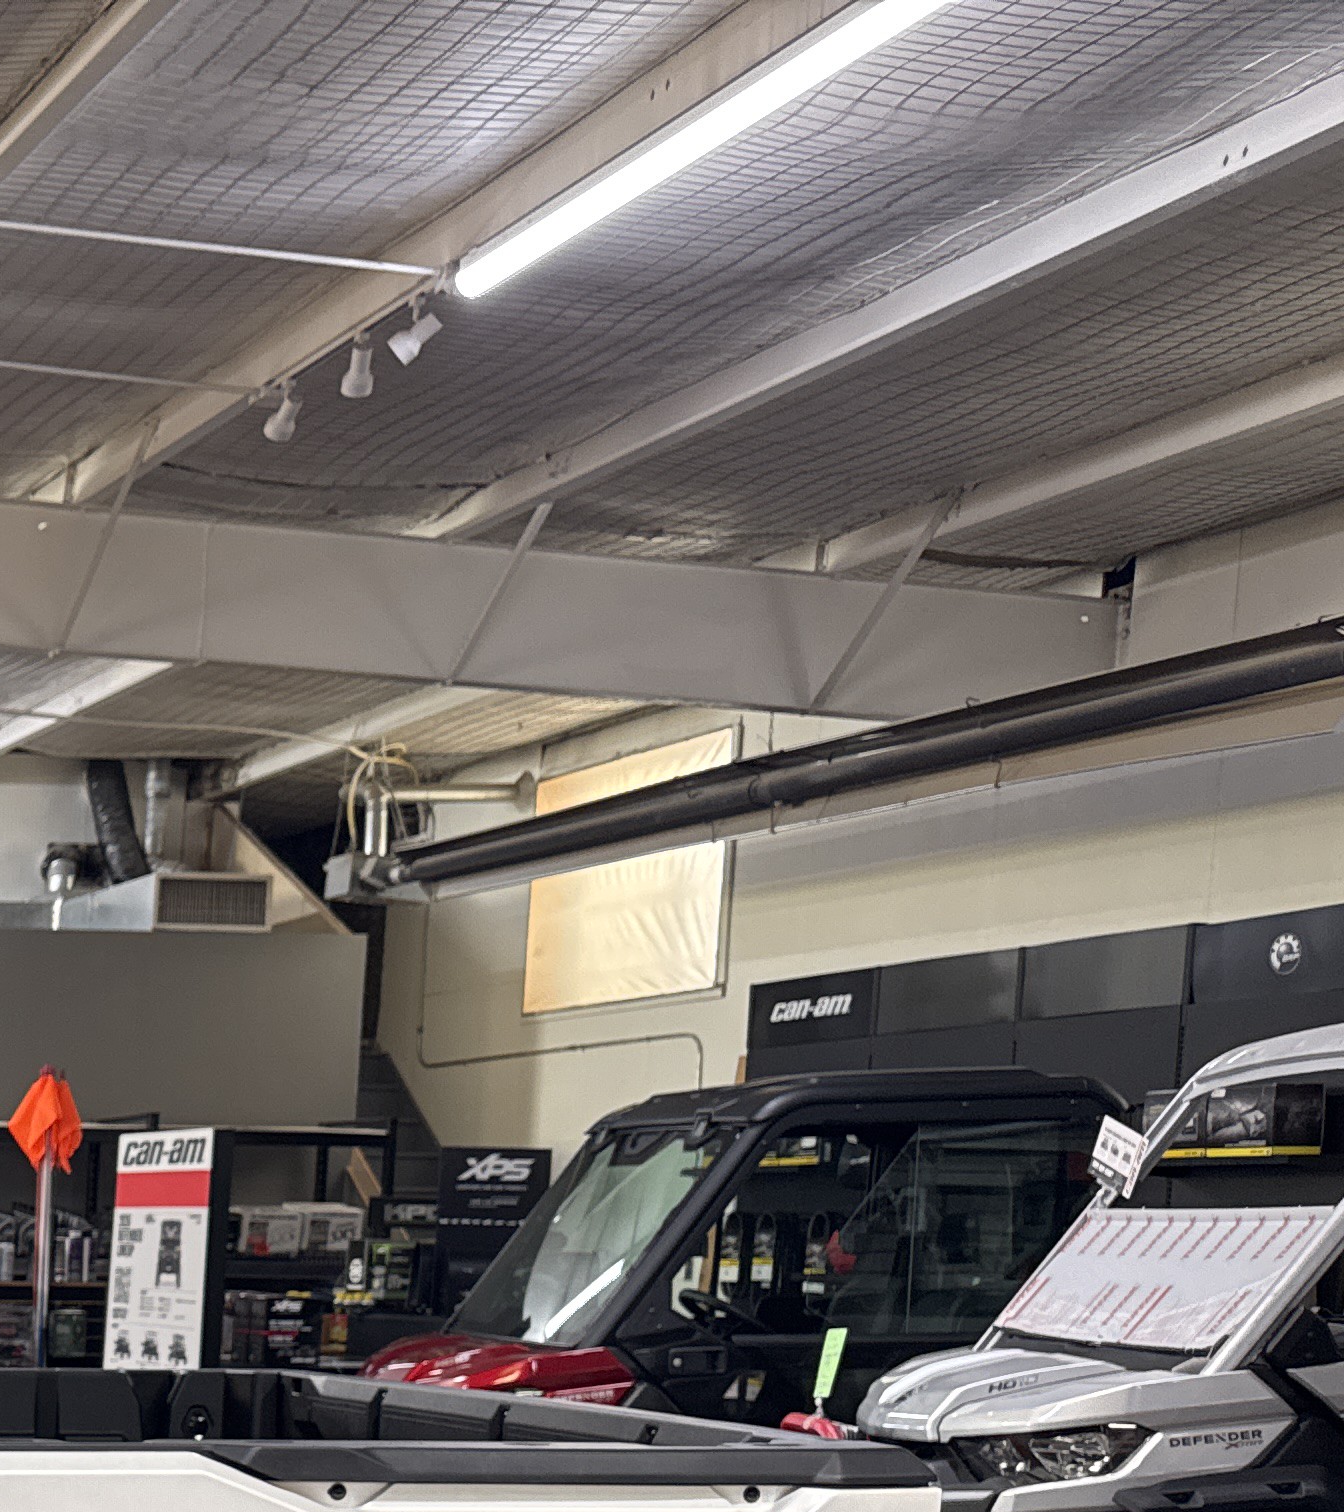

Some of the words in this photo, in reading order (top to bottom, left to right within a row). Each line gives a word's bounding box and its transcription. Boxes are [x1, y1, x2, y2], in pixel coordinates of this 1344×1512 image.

[770, 993, 852, 1024] can-am
[122, 1137, 207, 1166] can-am
[456, 1152, 536, 1182] XPS
[1169, 1428, 1263, 1448] DEFENDER
